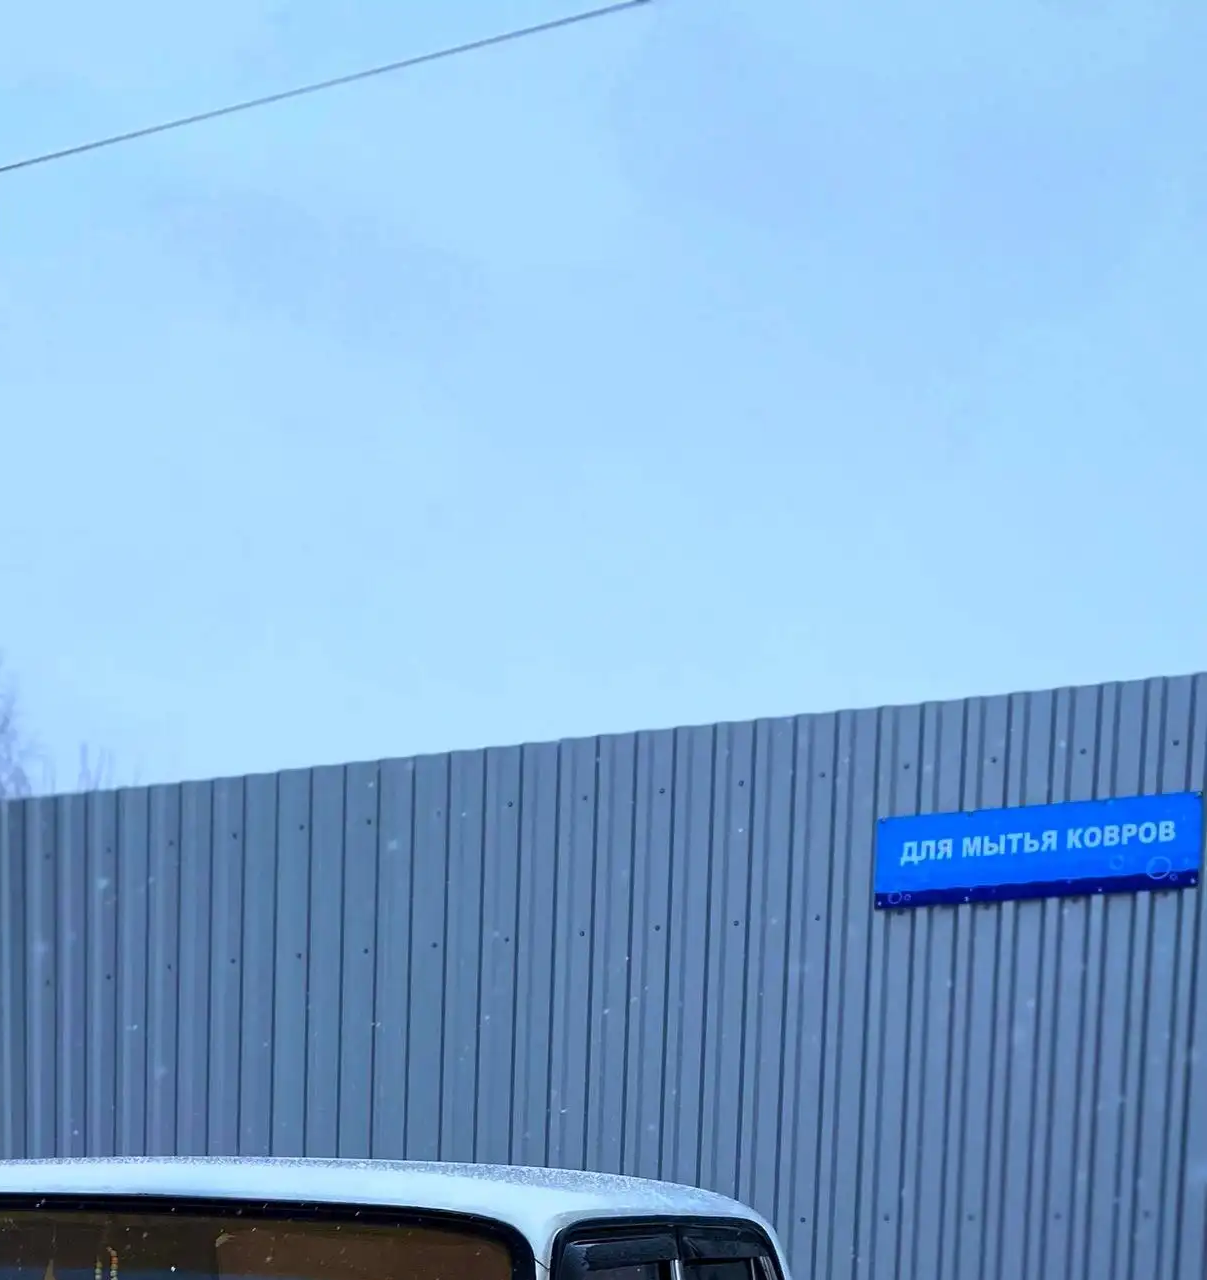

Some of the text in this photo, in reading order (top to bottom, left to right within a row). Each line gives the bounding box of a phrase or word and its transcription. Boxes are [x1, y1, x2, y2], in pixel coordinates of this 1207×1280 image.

[900, 820, 1176, 867] ДЛЯ МЫТЬЯ КОВРОВ
